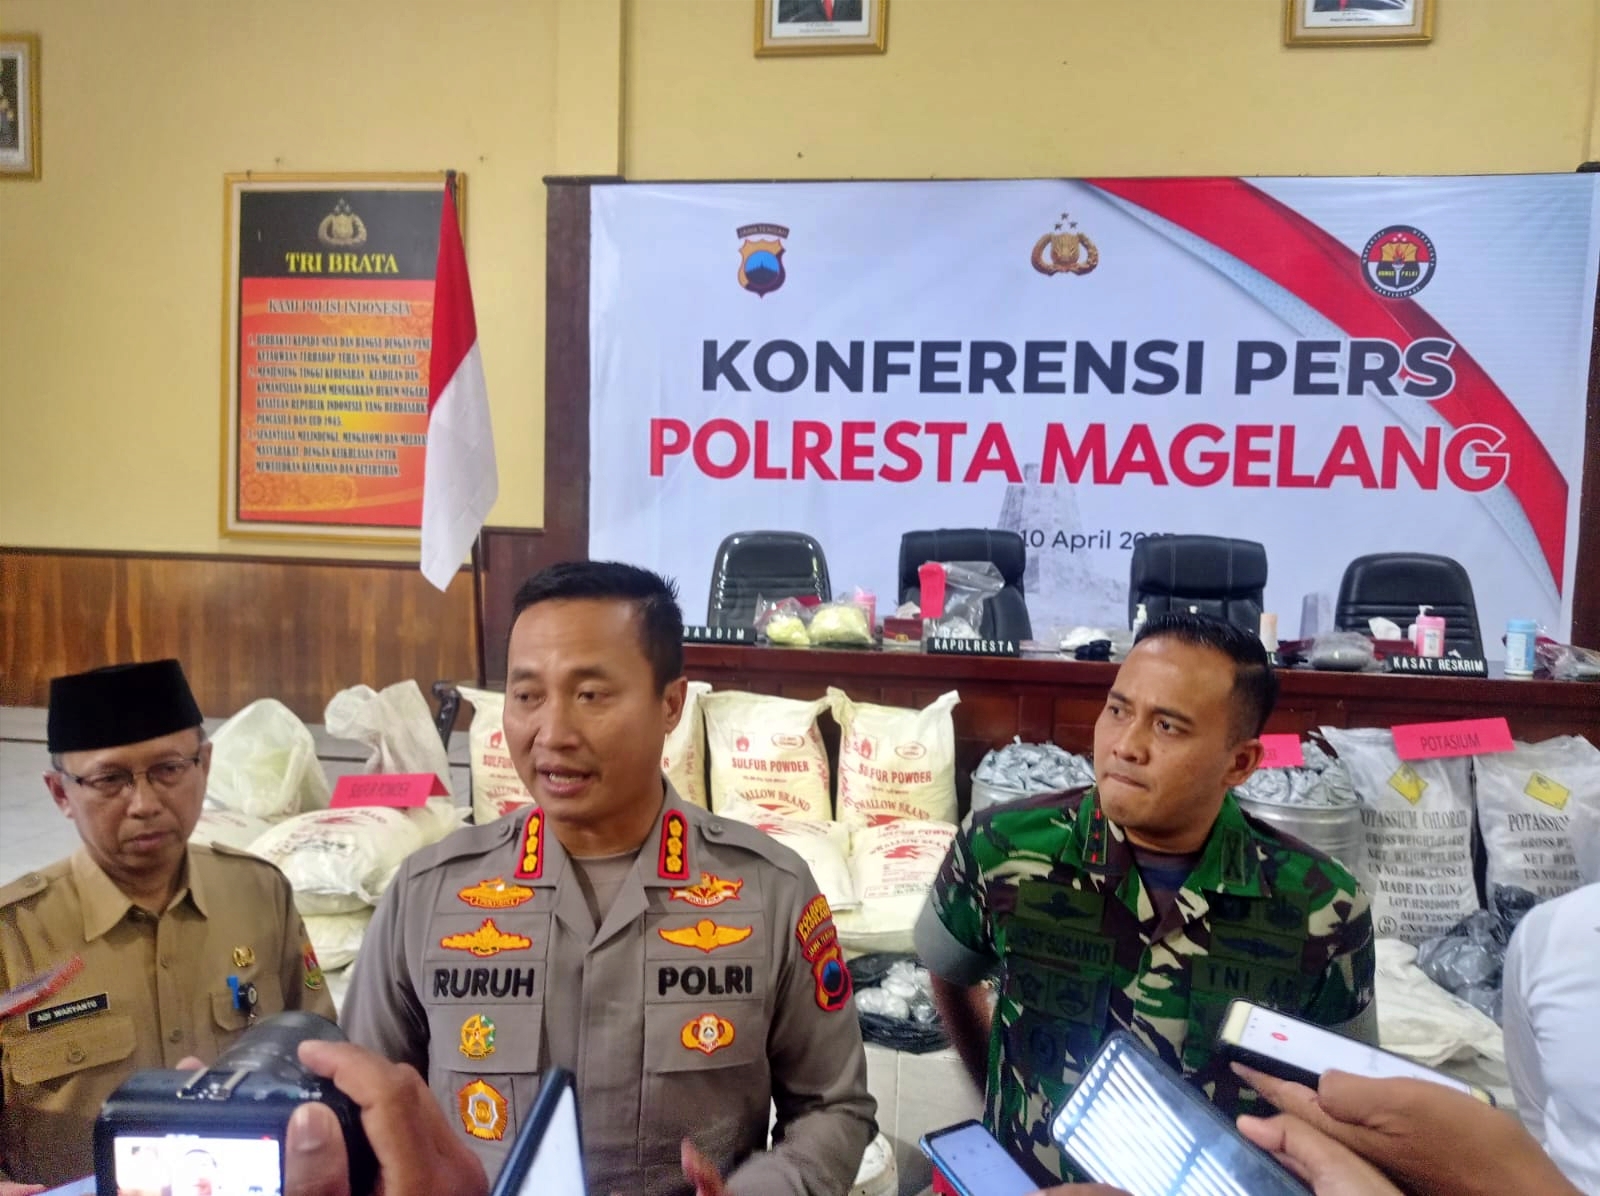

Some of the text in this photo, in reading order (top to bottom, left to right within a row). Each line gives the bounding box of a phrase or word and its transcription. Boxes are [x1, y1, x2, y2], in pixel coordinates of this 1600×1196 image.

[285, 252, 399, 273] TRI BRATA
[302, 299, 340, 313] POLISI
[345, 300, 411, 315] INDONESIA
[702, 338, 1457, 398] KONFERENSI PERS
[650, 417, 1511, 492] POLRESTA MAGELANG
[1020, 529, 1045, 548] 10
[1052, 529, 1111, 553] April
[934, 638, 1014, 653] KAPOLRESTA
[1393, 656, 1485, 673] KASAT RESKRIM
[1420, 732, 1481, 752] POTASIUM
[732, 757, 810, 773] SULFUR POWDER
[891, 770, 932, 784] POWDER
[778, 791, 811, 812] BRAND
[1379, 880, 1464, 897] MADE IN CHINA
[433, 967, 535, 998] RURUH
[658, 965, 753, 996] POLRI
[1206, 963, 1251, 992] TNI
